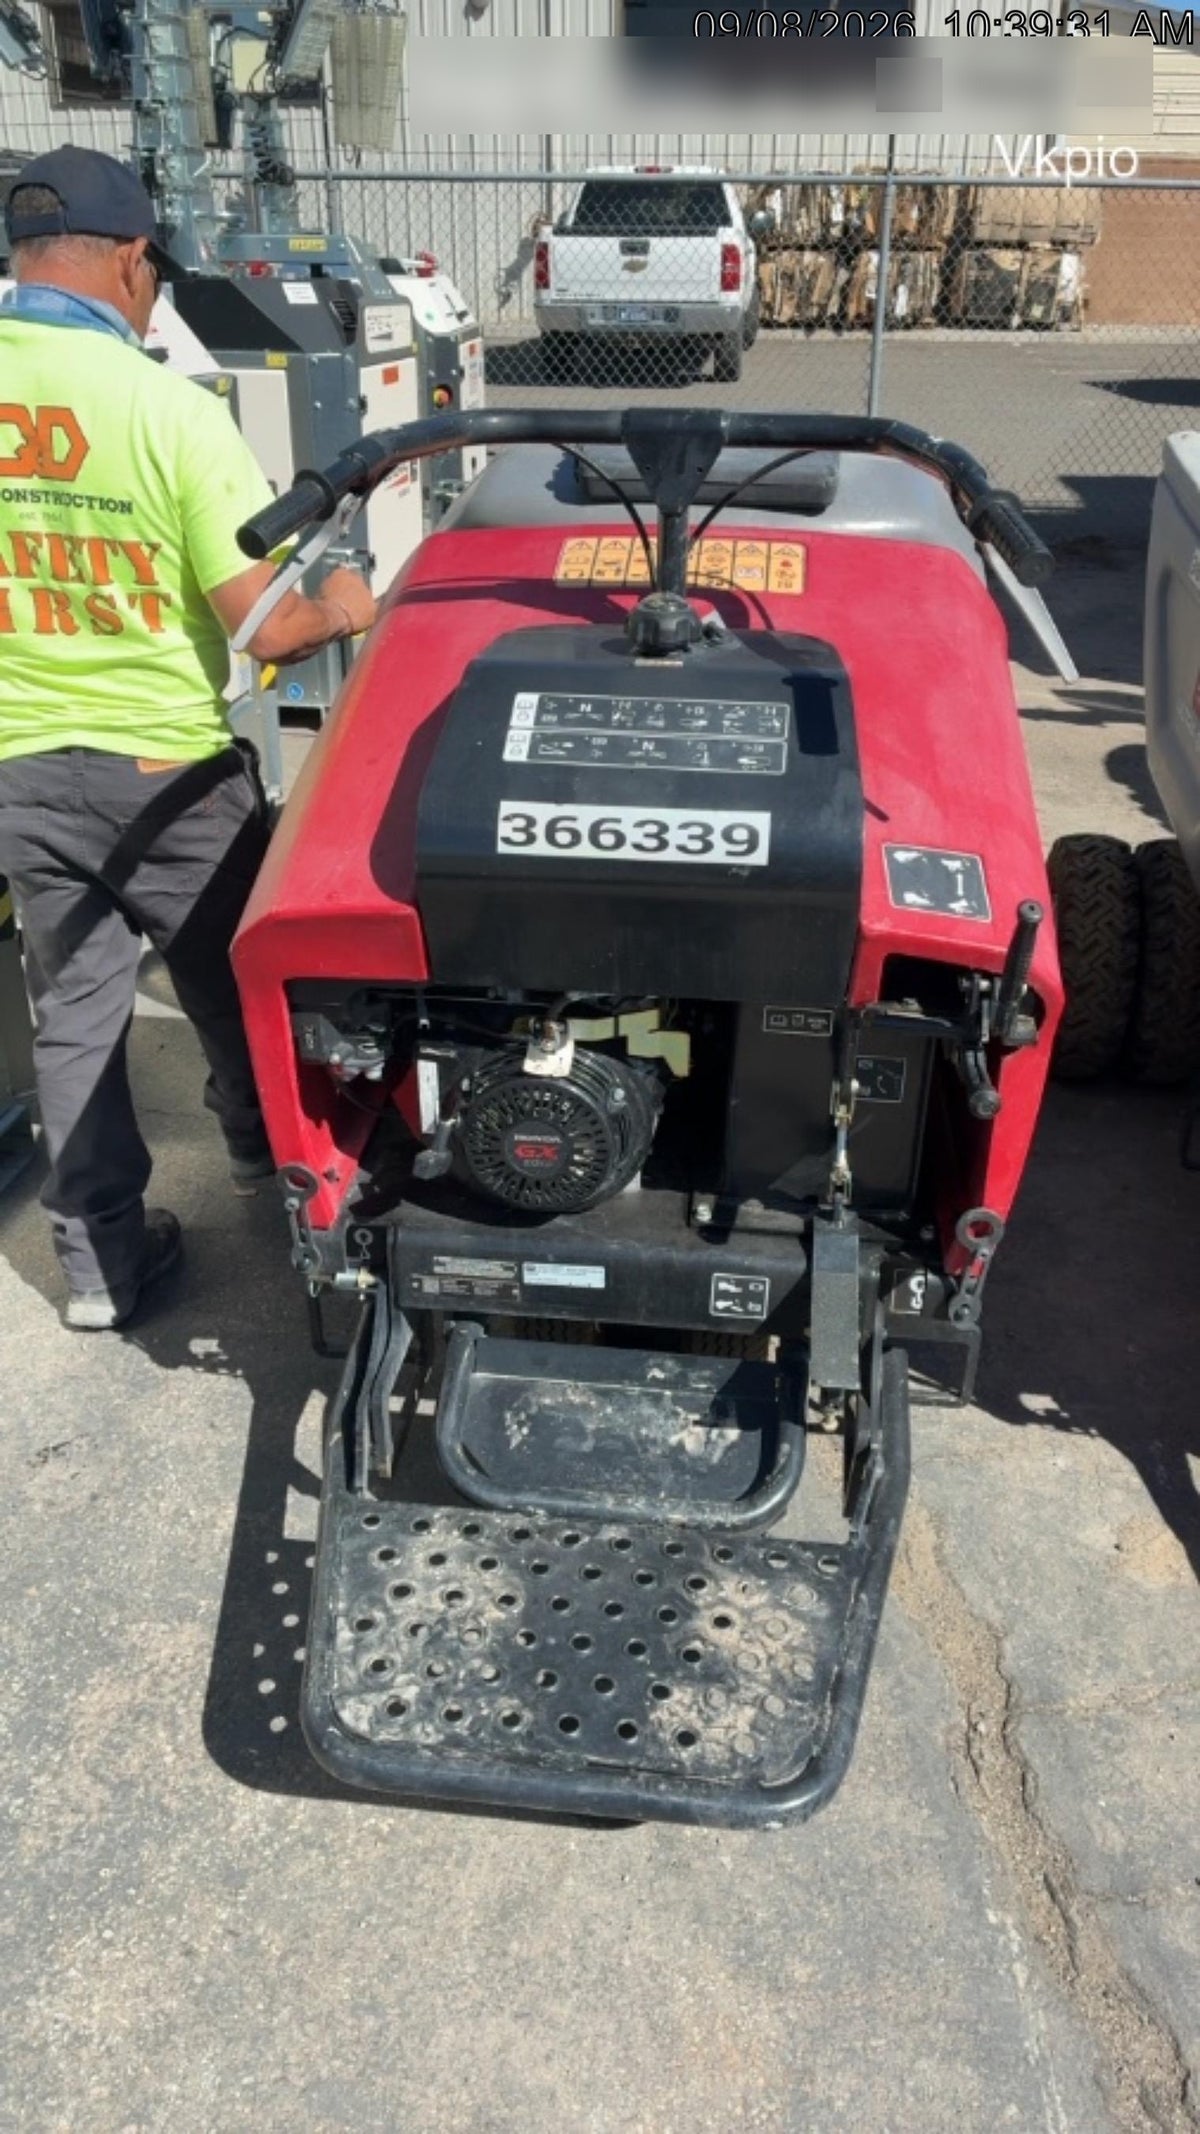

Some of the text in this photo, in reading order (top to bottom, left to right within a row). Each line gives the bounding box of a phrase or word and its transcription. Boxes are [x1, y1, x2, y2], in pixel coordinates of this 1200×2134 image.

[0, 487, 133, 515] ONSTRUCTION
[0, 531, 162, 586] FETY
[500, 812, 760, 857] 366339
